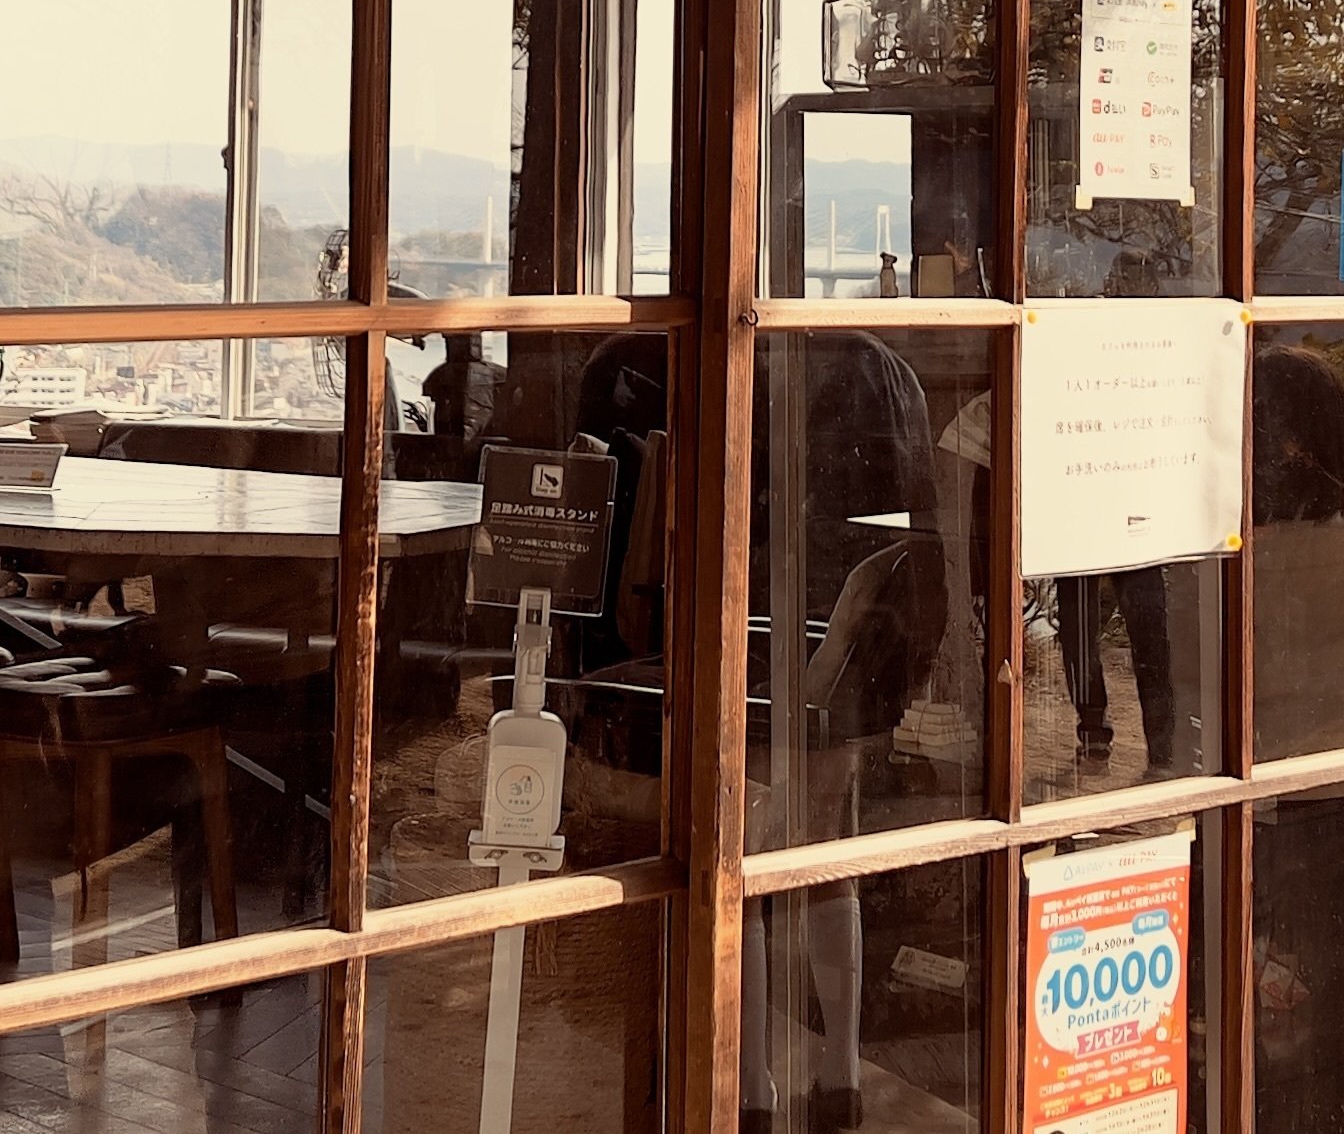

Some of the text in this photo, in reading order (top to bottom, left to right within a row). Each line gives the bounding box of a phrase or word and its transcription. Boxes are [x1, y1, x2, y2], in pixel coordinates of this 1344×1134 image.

[1047, 944, 1173, 1015] 10,000
[1068, 996, 1151, 1029] Pontaポイント
[1083, 1025, 1134, 1052] プレゼント
